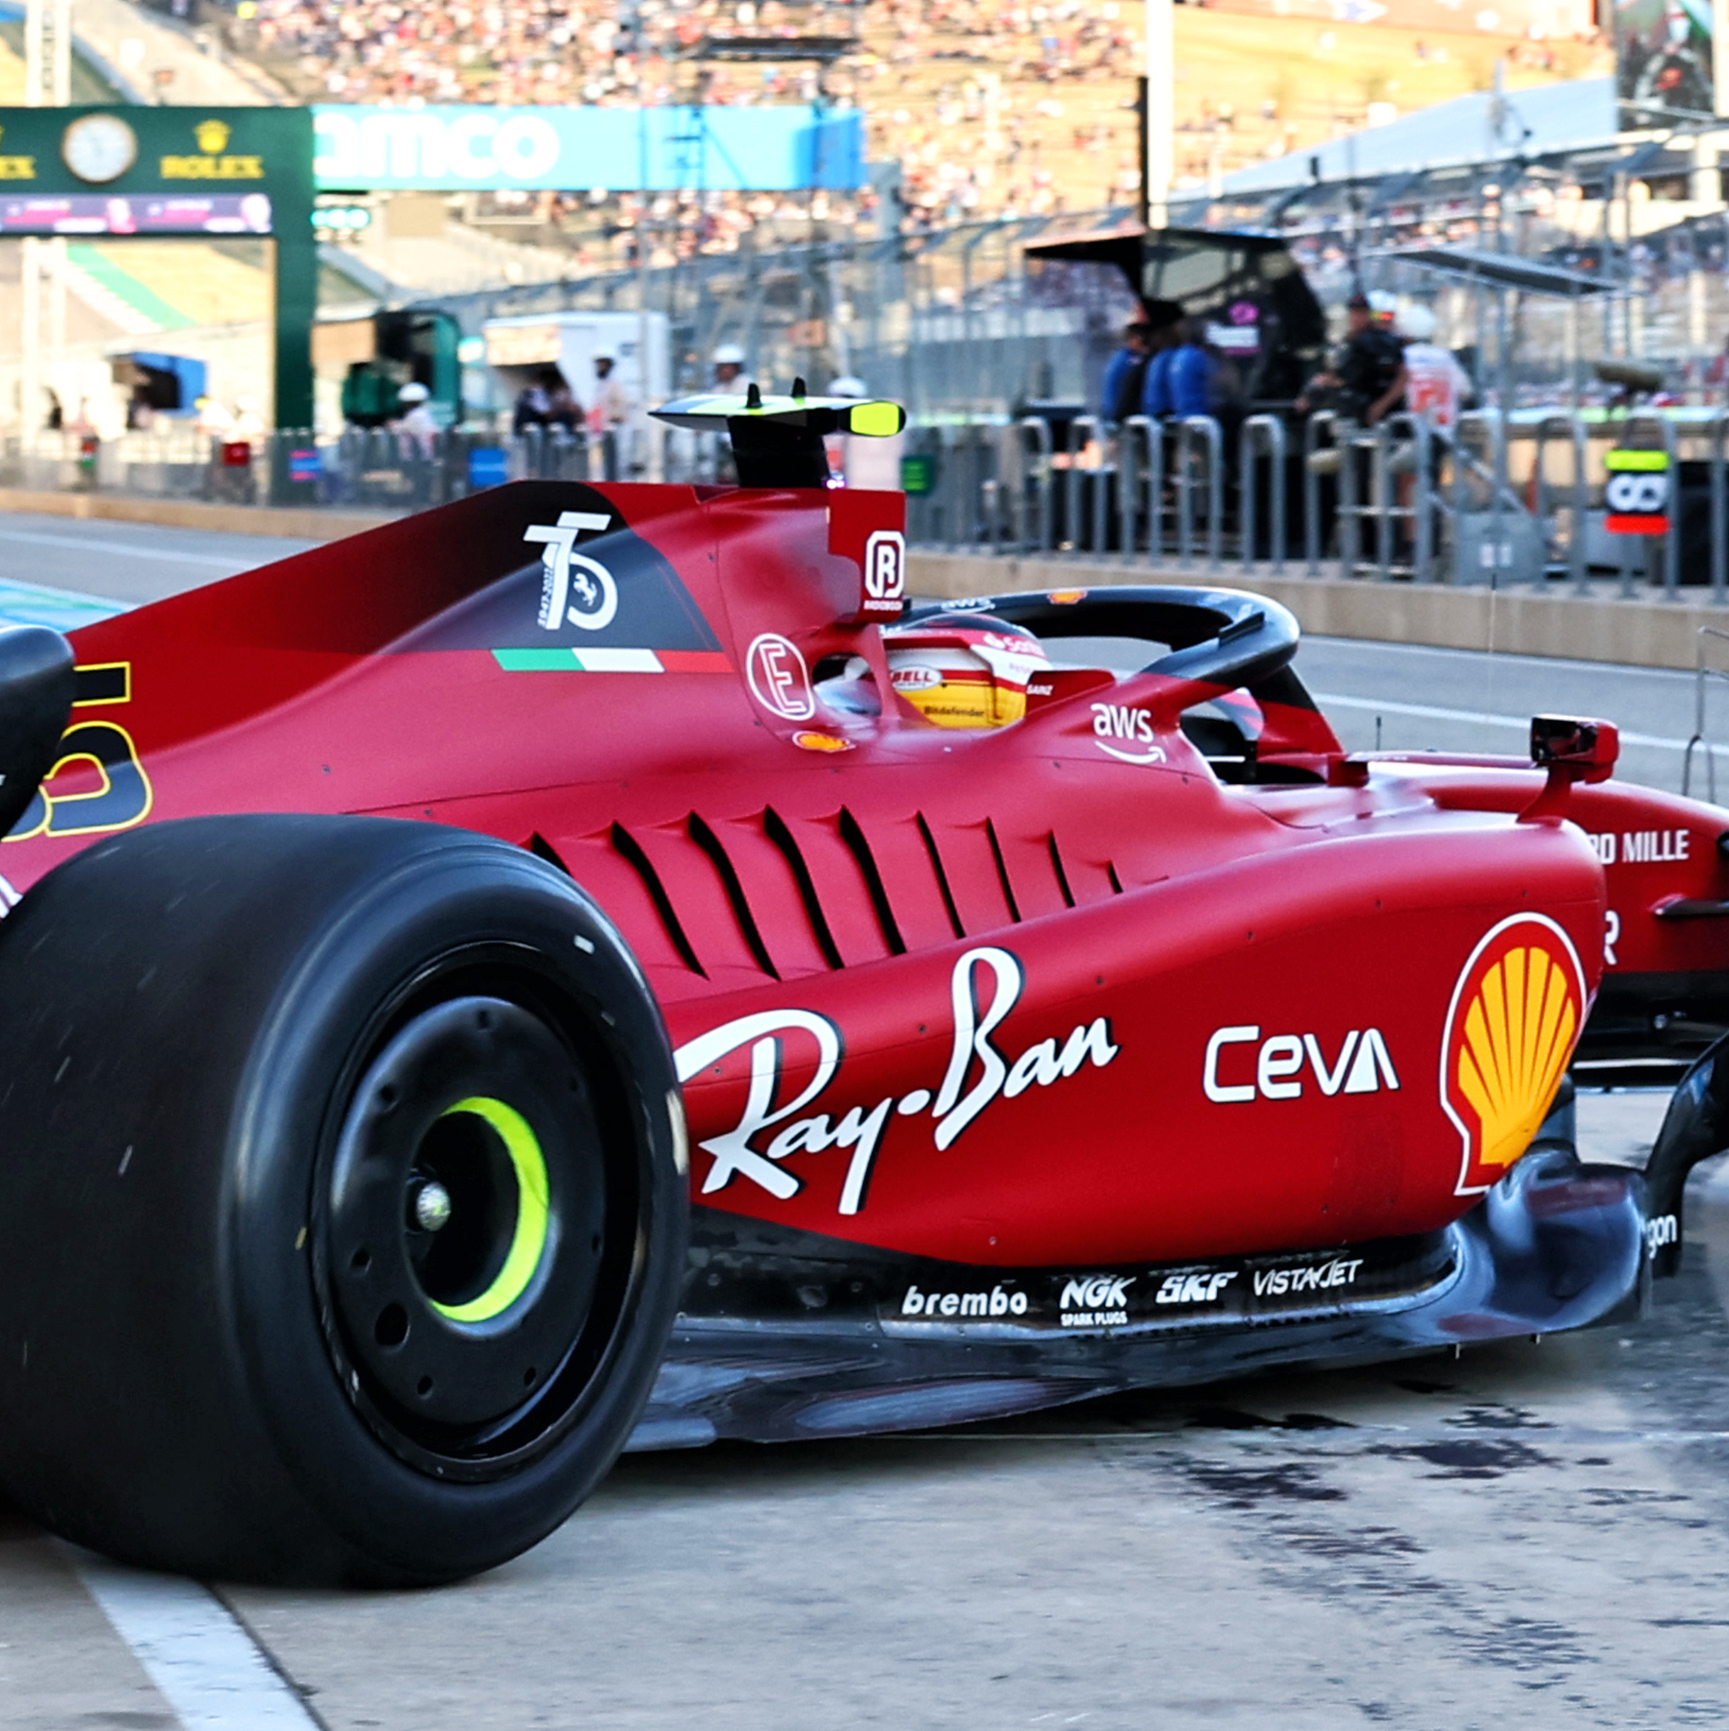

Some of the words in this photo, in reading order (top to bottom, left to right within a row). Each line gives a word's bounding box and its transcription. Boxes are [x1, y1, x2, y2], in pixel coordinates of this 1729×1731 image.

[160, 155, 265, 180] ROLEX
[891, 670, 933, 682] BELL
[1090, 702, 1155, 744] aws
[1623, 828, 1690, 863] MILLE
[672, 946, 1119, 1215] Ray-Ban
[901, 1286, 1029, 1317] brembo
[1059, 1277, 1137, 1309] NGK
[1154, 1271, 1239, 1304] SKF
[1060, 1313, 1092, 1327] SPARK
[1095, 1312, 1129, 1325] PLUGS
